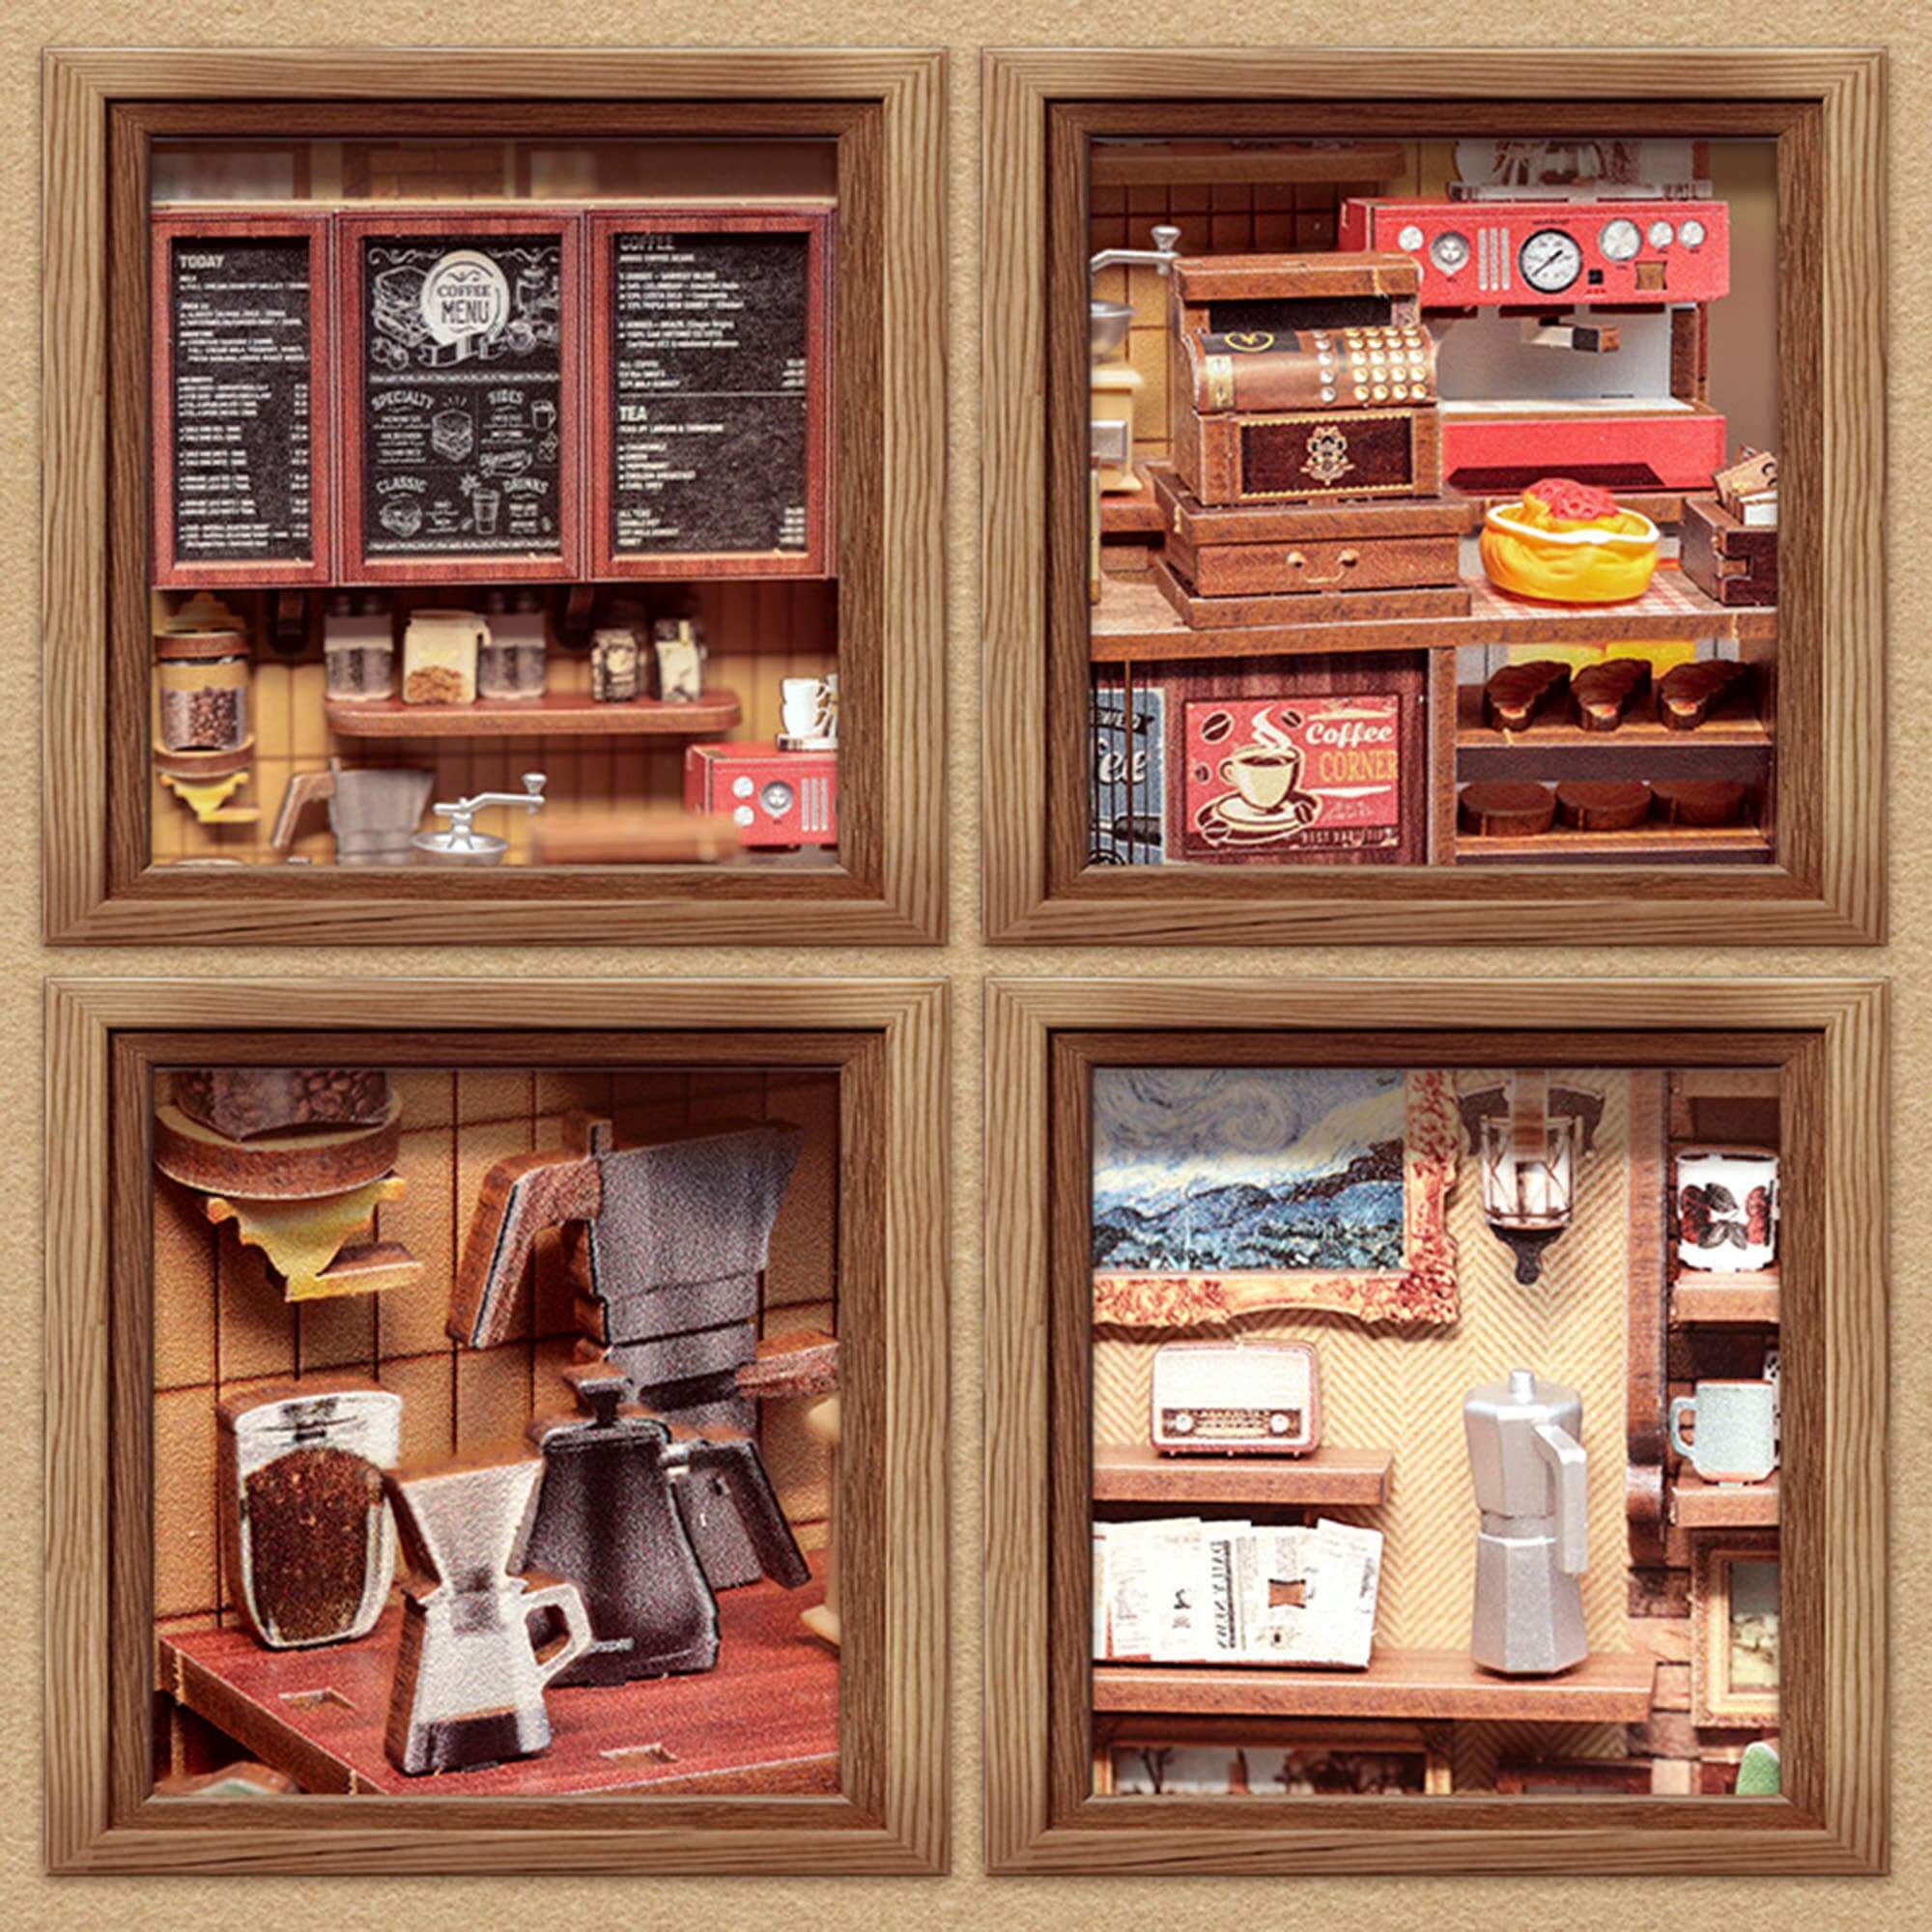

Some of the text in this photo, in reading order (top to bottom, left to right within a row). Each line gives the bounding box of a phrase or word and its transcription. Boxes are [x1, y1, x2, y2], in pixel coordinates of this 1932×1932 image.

[179, 254, 224, 270] TODAY
[438, 284, 492, 298] COFFEE
[441, 299, 490, 325] MENU
[371, 389, 434, 412] SPECIALTY
[618, 405, 648, 422] TEA
[376, 476, 428, 495] CLASSIC
[1306, 722, 1394, 749] Coffee
[1320, 750, 1398, 782] CORNER
